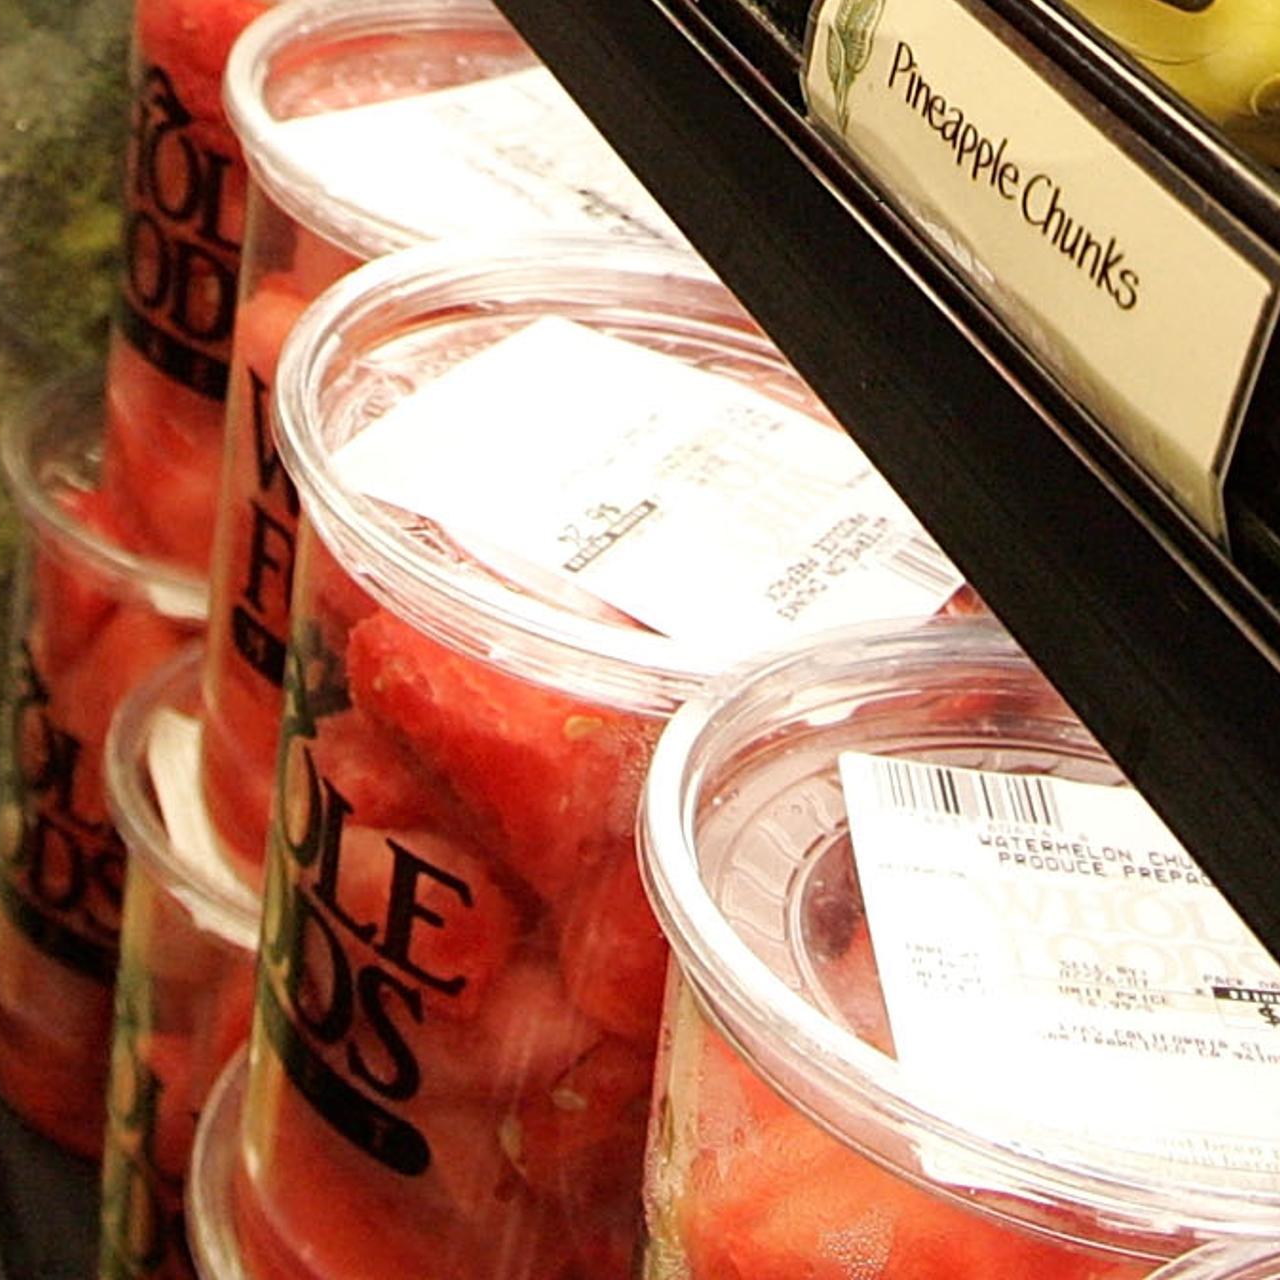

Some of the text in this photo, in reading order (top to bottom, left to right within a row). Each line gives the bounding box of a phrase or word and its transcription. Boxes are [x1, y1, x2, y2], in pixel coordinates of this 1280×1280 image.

[887, 41, 1140, 312] Pineapple Chunks
[977, 833, 1195, 870] WATERMELON CHU
[998, 851, 1107, 877] PRODUCE
